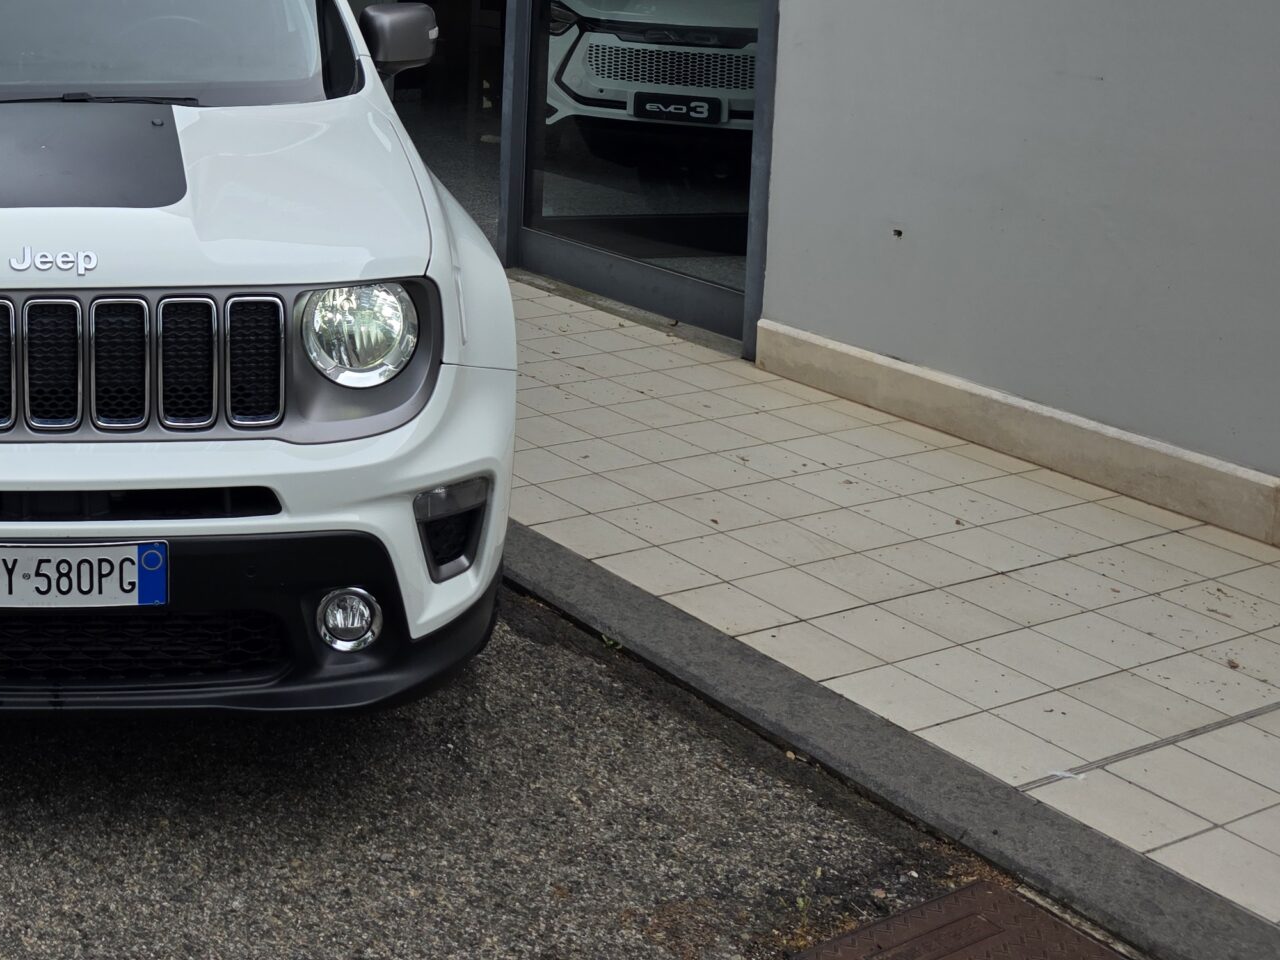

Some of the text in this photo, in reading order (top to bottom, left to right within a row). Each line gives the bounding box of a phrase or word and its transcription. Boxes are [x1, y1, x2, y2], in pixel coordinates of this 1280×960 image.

[645, 101, 709, 118] EVO 3
[9, 245, 98, 276] Jeep
